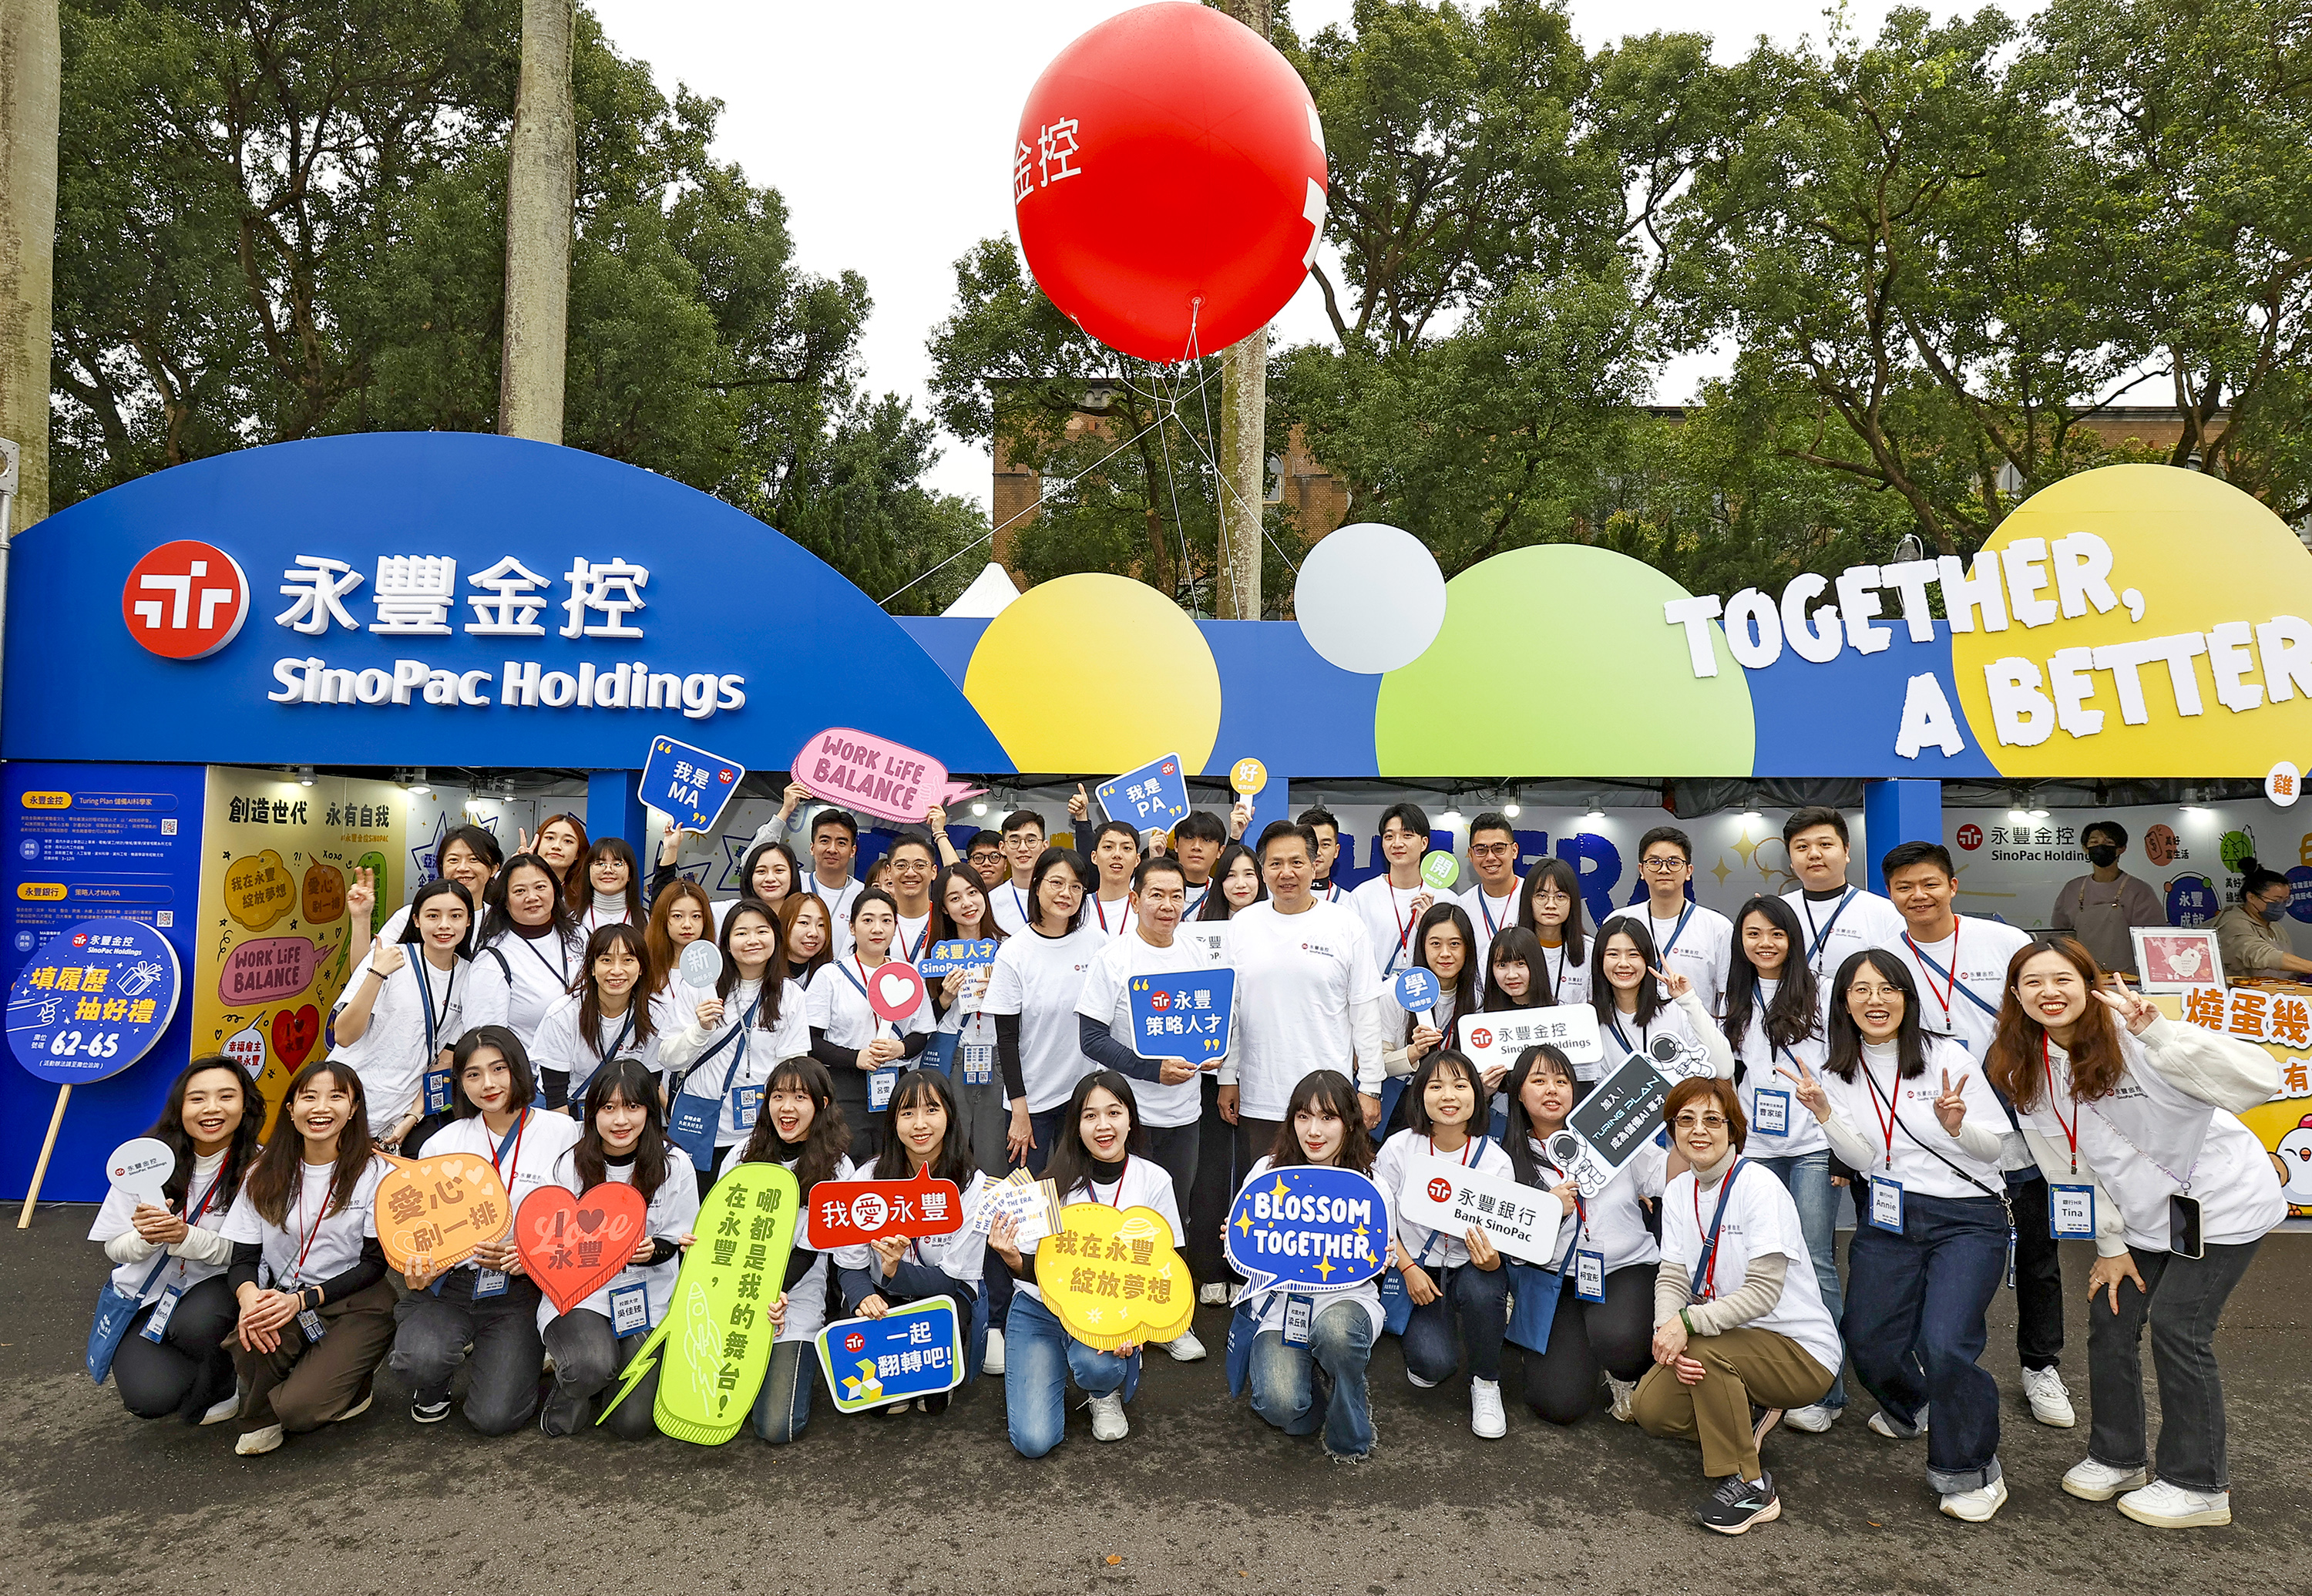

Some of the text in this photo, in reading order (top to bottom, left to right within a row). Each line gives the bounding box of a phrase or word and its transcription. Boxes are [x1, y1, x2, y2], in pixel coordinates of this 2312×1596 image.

[1014, 116, 1081, 205] 金控
[274, 554, 650, 639] 永豐金控
[1663, 531, 2146, 679] TOGETHER,
[267, 657, 746, 721] SinoPac Holdings
[1894, 615, 2312, 760] A BETTER
[822, 735, 882, 771] WORK
[674, 760, 710, 791] 我是
[812, 758, 919, 810] BALANCE
[1238, 762, 1258, 782] 好
[667, 781, 699, 809] MA
[1125, 777, 1162, 805] 我是
[2273, 774, 2294, 797] 雞
[29, 795, 63, 805] 永豐金控
[229, 795, 390, 829] 創造世代 永有自我
[1136, 798, 1167, 818] PA
[1991, 826, 2075, 845] 永豐金控
[1430, 855, 1454, 879] 開
[1991, 849, 2092, 864] SinoPac Holding
[25, 887, 59, 896] 永豐銀行
[231, 867, 276, 892] 我在永豐
[308, 876, 333, 895] 愛心
[242, 883, 287, 909] 綻放夢想
[312, 897, 341, 913] 刷一排
[2179, 891, 2203, 907] 永豐
[87, 946, 142, 956] SinoPac Holdings
[89, 935, 134, 947] 永豐金控
[935, 943, 993, 960] 永豐人才
[235, 949, 274, 969] WORK
[687, 945, 709, 973] 新
[922, 963, 965, 973] SinoPac
[29, 966, 110, 993] 填履歷
[234, 966, 300, 993] BALANCE
[1404, 972, 1429, 997] 學
[75, 996, 156, 1023] 抽好禮
[1174, 989, 1211, 1010] 永豐
[1145, 1013, 1222, 1037] 策略人才
[2186, 987, 2310, 1043] 燒蛋幾
[50, 1030, 119, 1058] 62-65
[1498, 1023, 1568, 1042] 永豐金控
[229, 1040, 261, 1053] 幸福雇主
[1500, 1043, 1531, 1054] SinoP
[230, 1055, 260, 1066] 是永豐
[1592, 1075, 1661, 1140] TURING PLAN
[127, 1158, 157, 1171] 永豐金控
[388, 1177, 464, 1225] 愛心
[822, 1191, 949, 1228] 我愛永豐
[1254, 1191, 1371, 1226] BLOSSOM
[1457, 1188, 1536, 1227] 永豐銀行
[1877, 1199, 1897, 1211] Annie
[2062, 1208, 2082, 1217] Tina
[412, 1201, 499, 1252] 刷一排
[1454, 1208, 1532, 1242] Bank SinoPac
[548, 1241, 602, 1270] 永豐
[1054, 1231, 1154, 1267] 我在永豐
[1070, 1266, 1172, 1305] 綻放夢想
[886, 1321, 932, 1346] 一起
